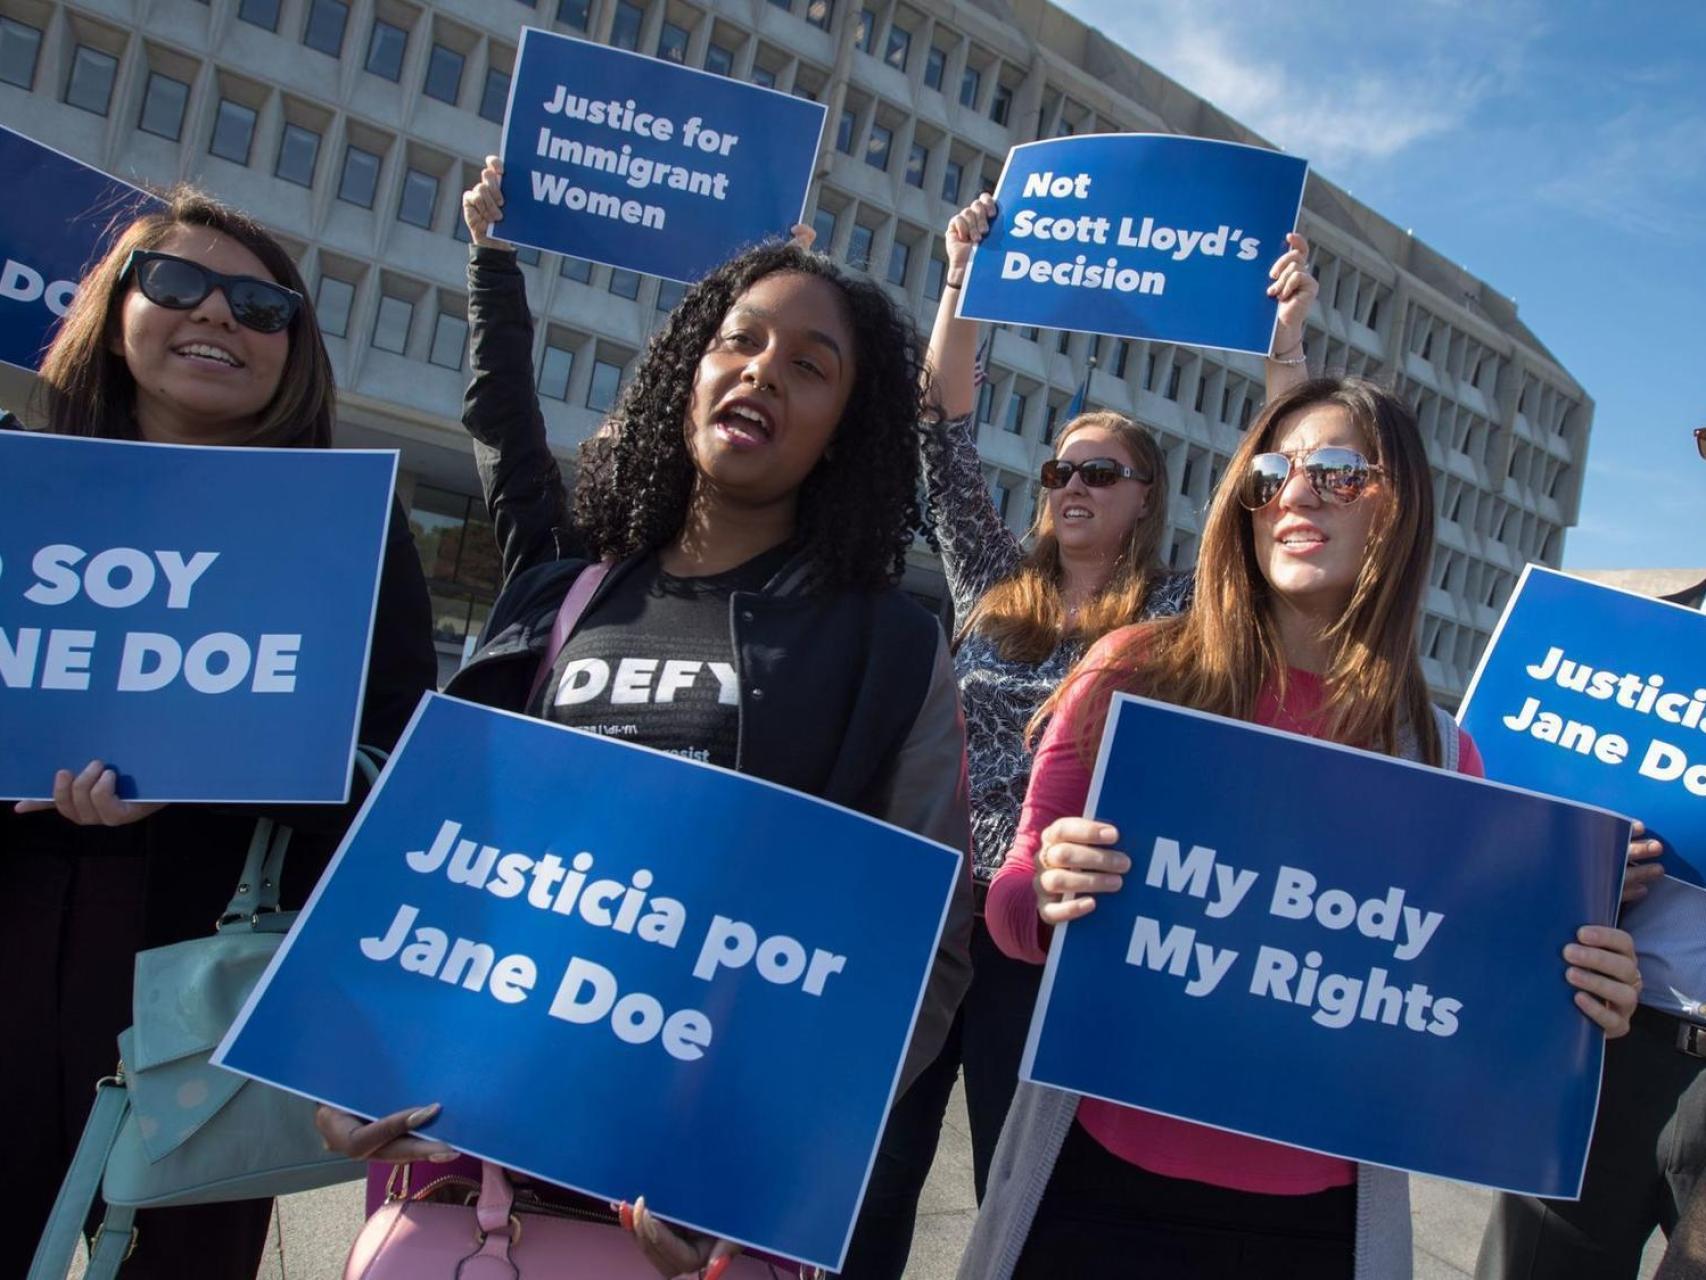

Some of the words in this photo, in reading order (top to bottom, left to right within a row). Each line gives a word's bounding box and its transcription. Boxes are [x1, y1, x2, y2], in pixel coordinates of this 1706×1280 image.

[544, 85, 673, 140] Justice
[683, 117, 738, 155] for
[537, 127, 728, 199] Immigrant
[1023, 172, 1091, 198] Not
[532, 171, 665, 229] Women
[1010, 210, 1110, 243] Scott
[1118, 218, 1259, 260] Lloyd's
[1002, 252, 1165, 294] Decision
[24, 543, 220, 609] SOY
[117, 632, 301, 693] DOE
[555, 658, 738, 705] DEFY
[1527, 647, 1706, 732] Justici
[1504, 698, 1628, 764] Jane
[1639, 740, 1706, 796] Do
[405, 819, 685, 947] Justicia
[693, 915, 846, 996] por
[1146, 837, 1258, 918] My
[1270, 866, 1444, 960] Body
[359, 904, 536, 1003] Jane
[549, 957, 712, 1060] Doe
[1126, 916, 1238, 996] My
[1250, 946, 1463, 1036] Rights
